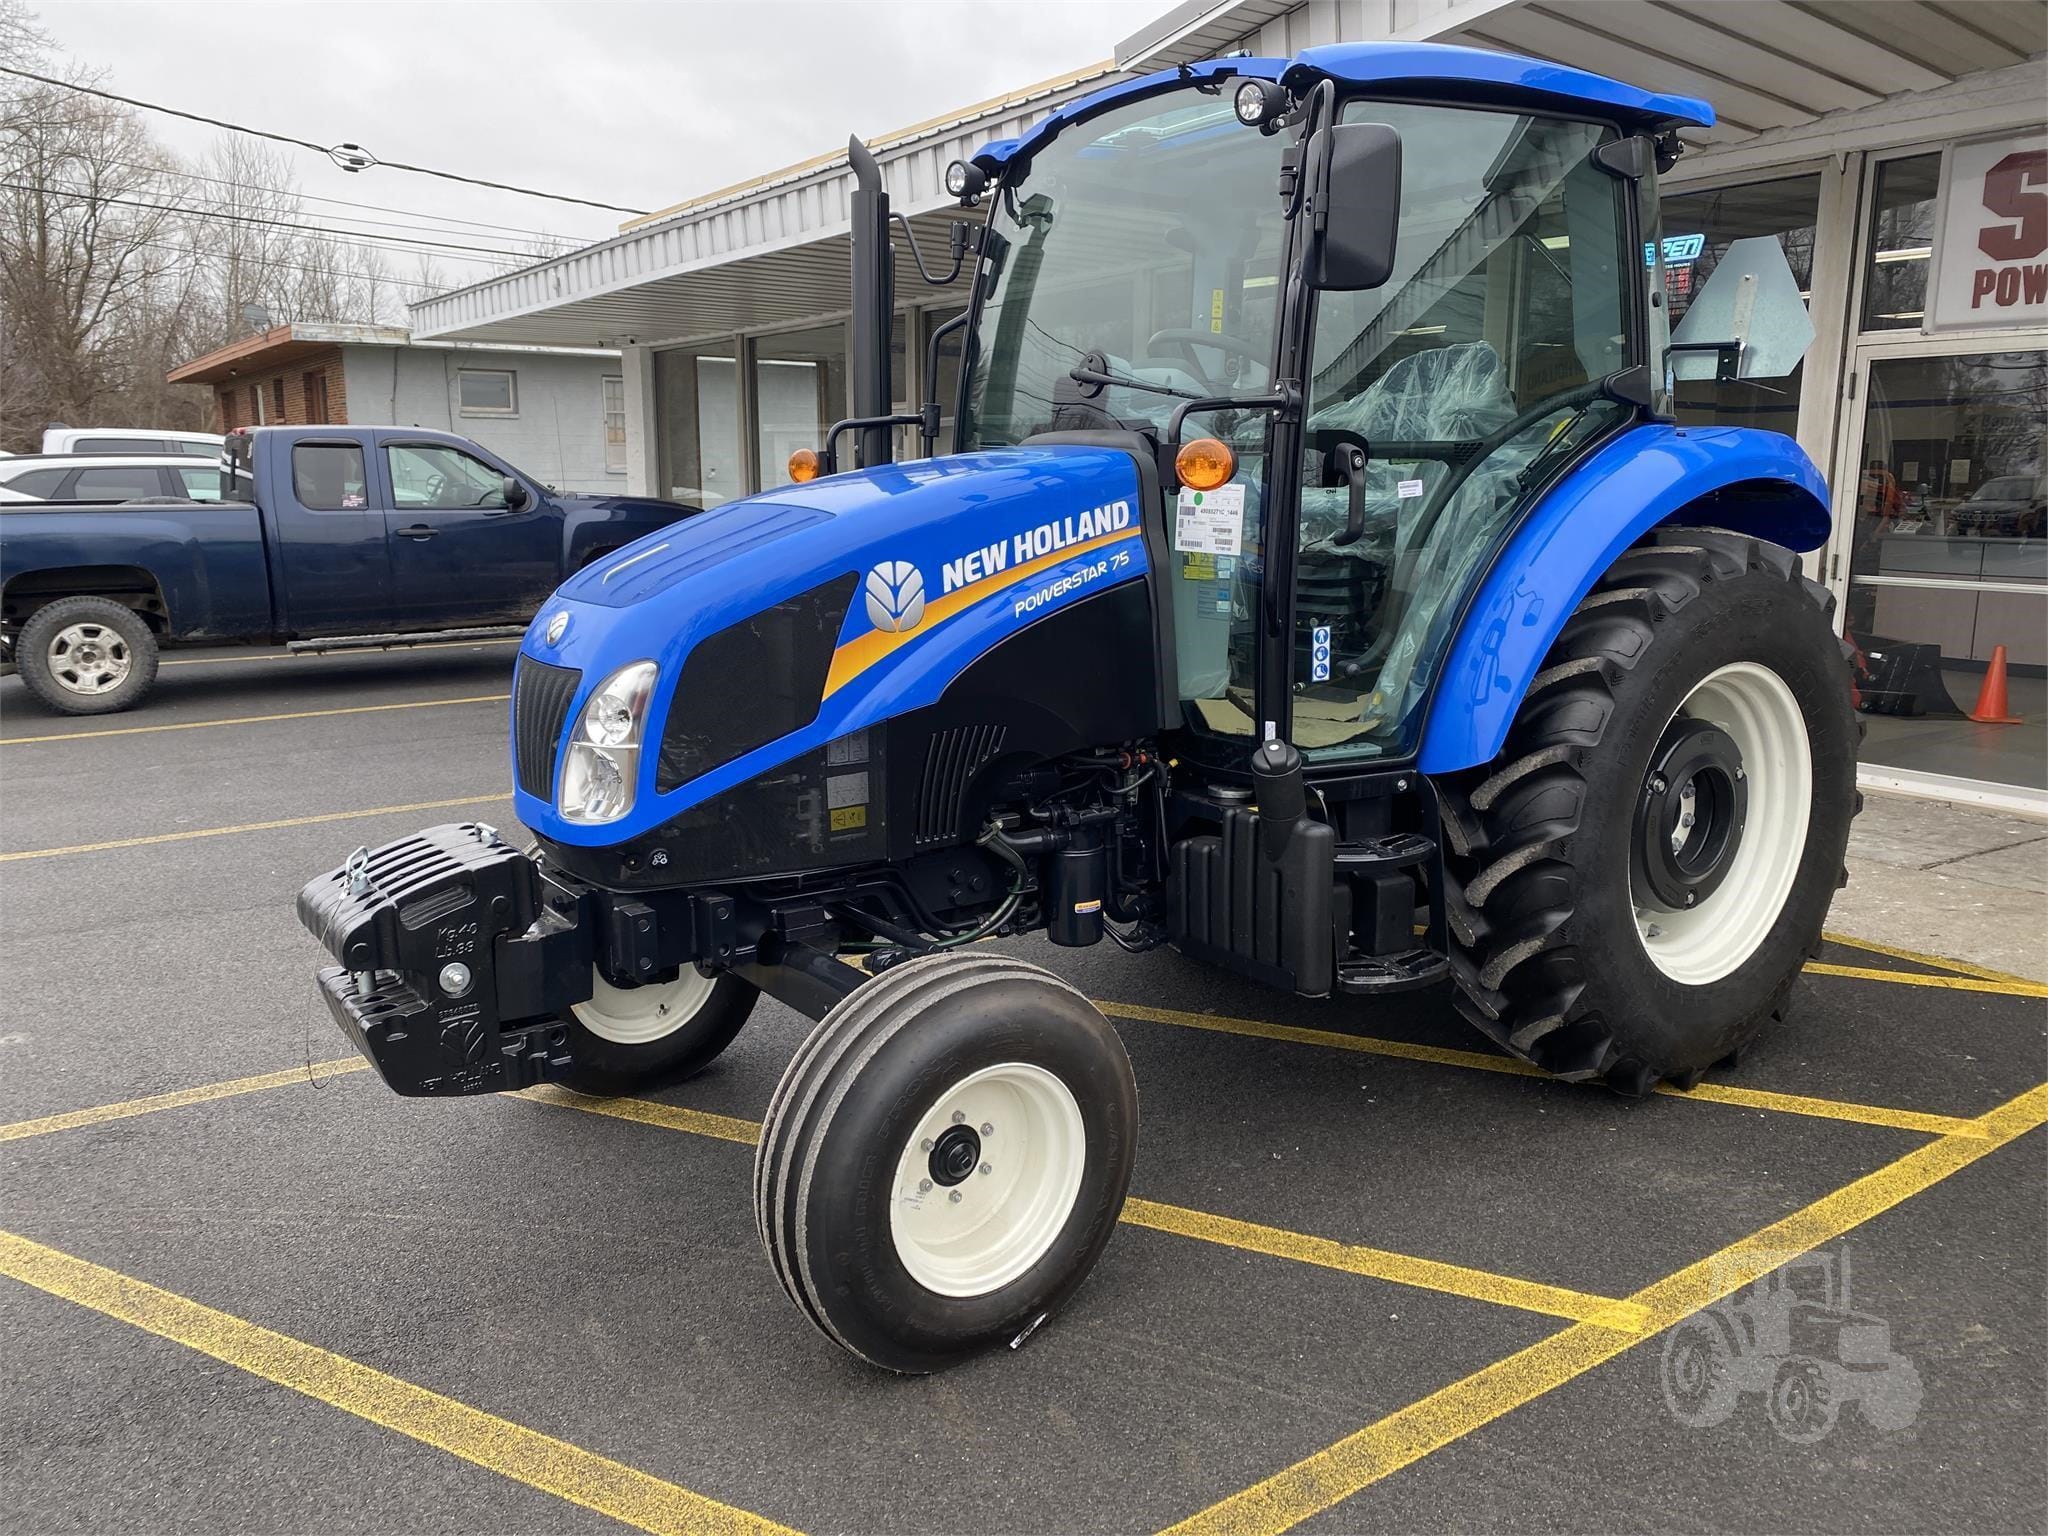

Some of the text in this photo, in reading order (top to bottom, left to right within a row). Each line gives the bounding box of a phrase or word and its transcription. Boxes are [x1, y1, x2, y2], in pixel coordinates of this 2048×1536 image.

[943, 501, 1130, 593] NEW HOLLAND
[1015, 551, 1130, 618] POWERSTAR 75
